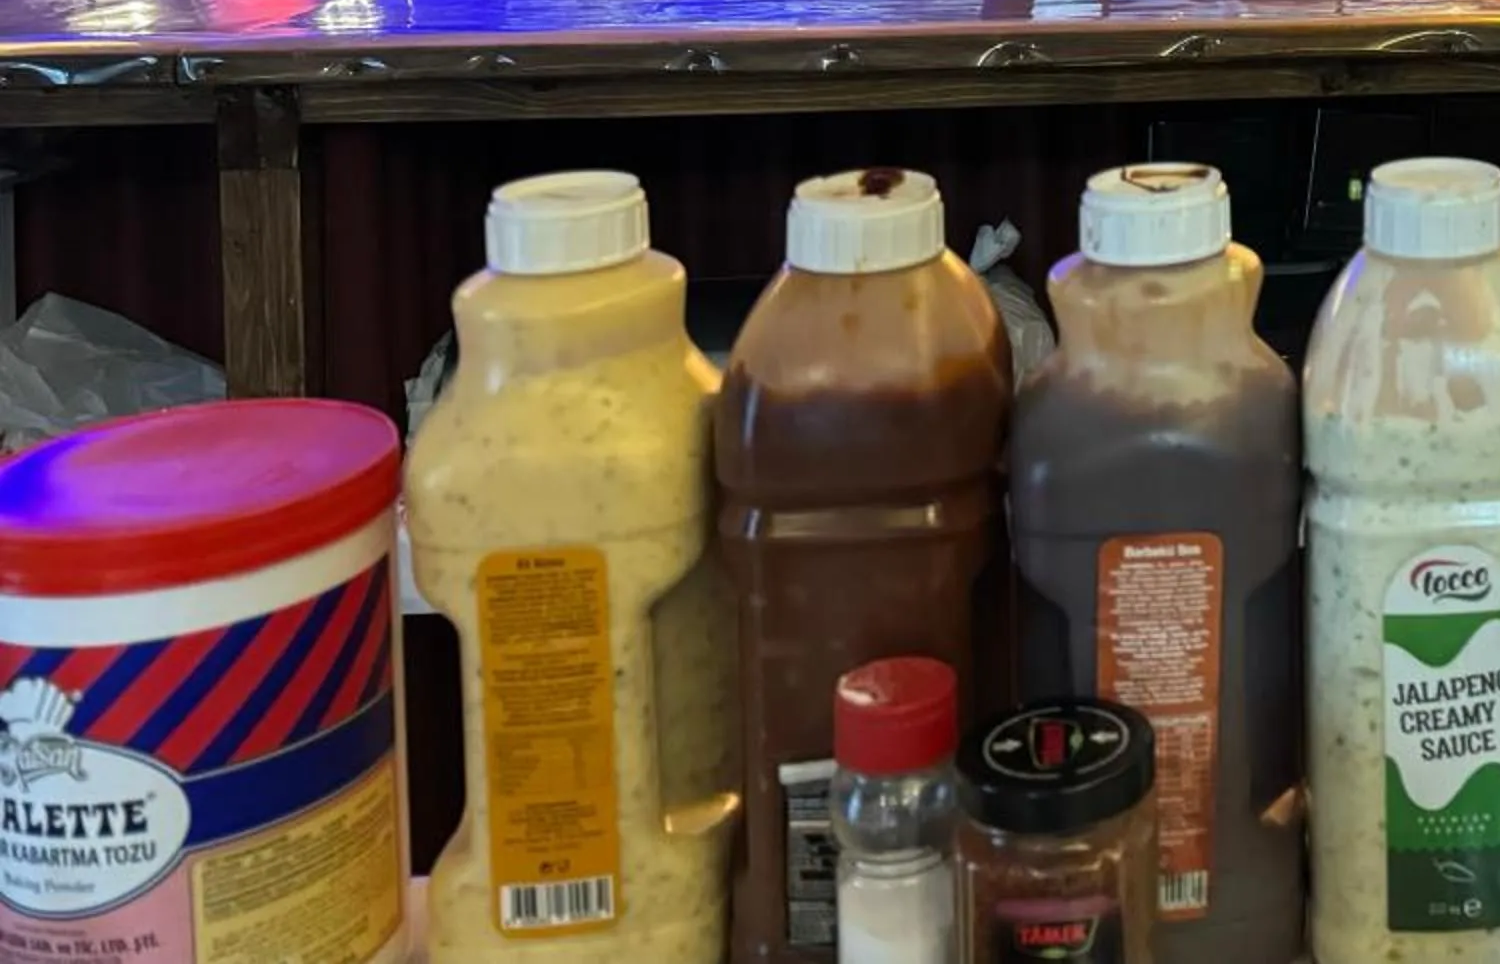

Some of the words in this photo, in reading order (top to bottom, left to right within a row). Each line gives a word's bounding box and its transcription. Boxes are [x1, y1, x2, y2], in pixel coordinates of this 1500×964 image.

[1400, 700, 1497, 734] CREAMY
[1420, 729, 1496, 762] SAUCE
[0, 798, 149, 838] ALETTE
[12, 843, 99, 868] KABARTMA
[104, 840, 157, 865] TOZU
